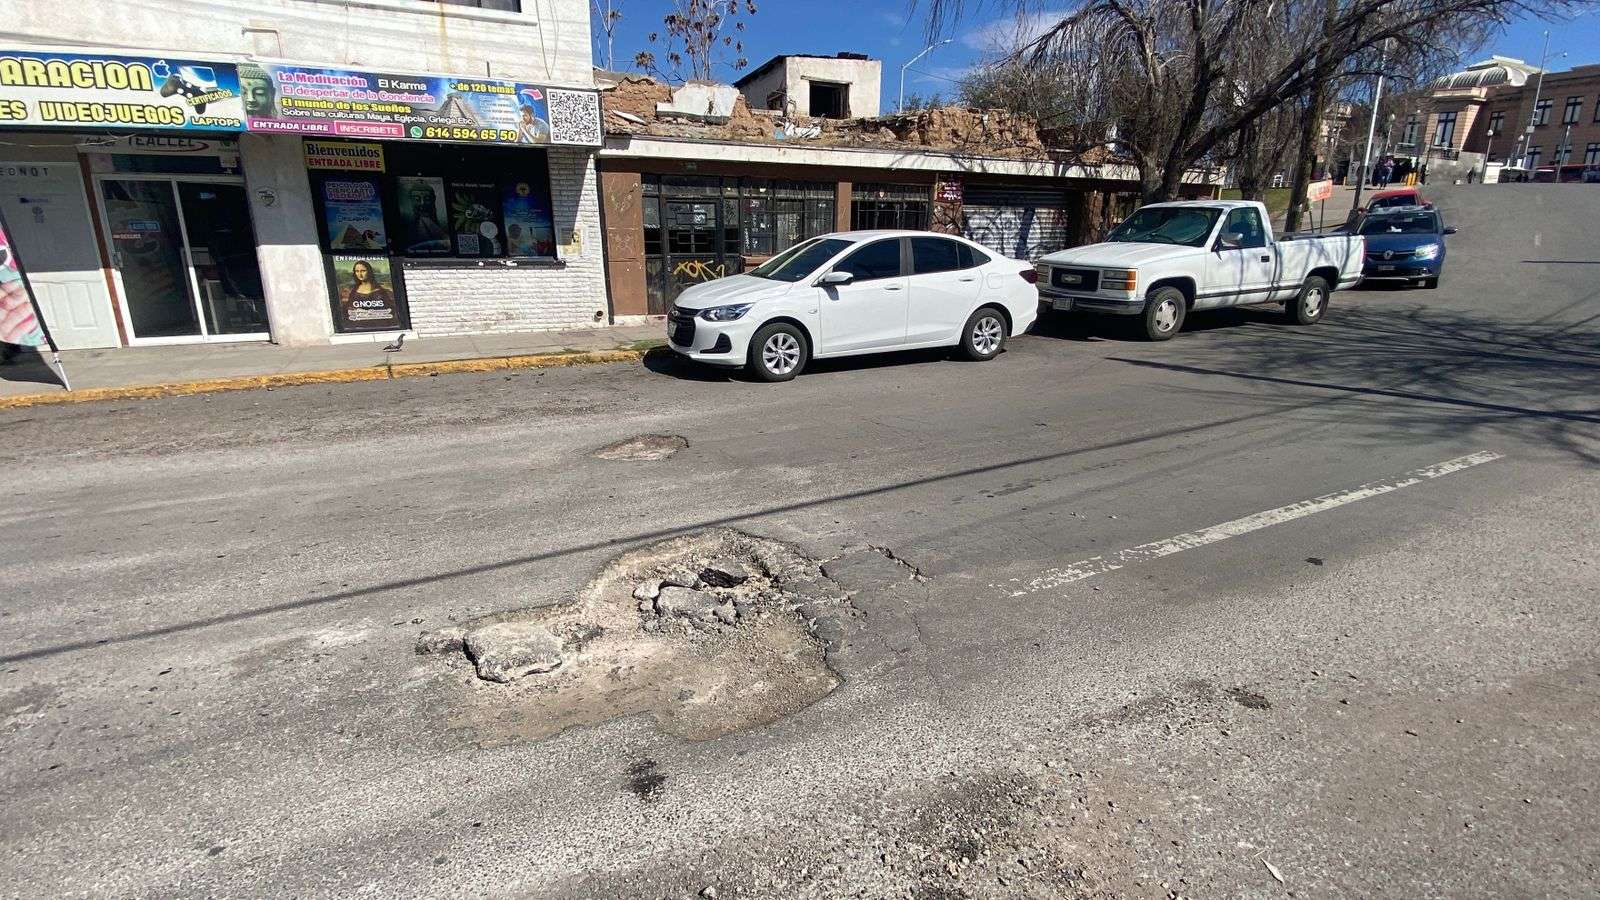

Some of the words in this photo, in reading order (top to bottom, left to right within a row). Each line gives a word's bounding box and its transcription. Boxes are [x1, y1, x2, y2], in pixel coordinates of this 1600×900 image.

[279, 72, 294, 83] La
[295, 73, 367, 87] Meditación
[378, 79, 388, 88] El
[391, 80, 426, 90] Karma
[283, 85, 293, 95] El
[296, 86, 349, 98] despertar
[352, 89, 366, 99] de
[368, 90, 378, 100] la
[379, 90, 435, 103] Conciencia
[457, 83, 469, 91] de
[470, 84, 487, 92] 120
[488, 85, 515, 95] temas
[186, 89, 233, 107] CERTIFICADOS
[282, 97, 292, 106] El
[294, 99, 334, 109] mundo
[336, 101, 350, 109] de
[352, 102, 369, 111] los
[371, 104, 411, 113] Sueños
[39, 101, 185, 126] VIDEOJUEGOS
[282, 108, 310, 116] Sobre
[312, 109, 326, 117] las
[328, 111, 365, 119] culturas
[367, 113, 393, 122] Maya,
[429, 116, 457, 125] Griega
[191, 116, 241, 127] LAPTOPS
[253, 121, 300, 130] ENTRADA
[302, 123, 329, 132] LIBRE
[339, 125, 399, 135] INSCRIBETE
[426, 127, 449, 138] 614
[452, 128, 478, 139] 594
[480, 129, 497, 140] 65
[500, 130, 516, 140] 50
[307, 143, 380, 157] Bienvenidos
[309, 158, 352, 168] ENTRADA
[355, 160, 381, 168] LIBRE
[352, 300, 384, 308] GNOSIS
